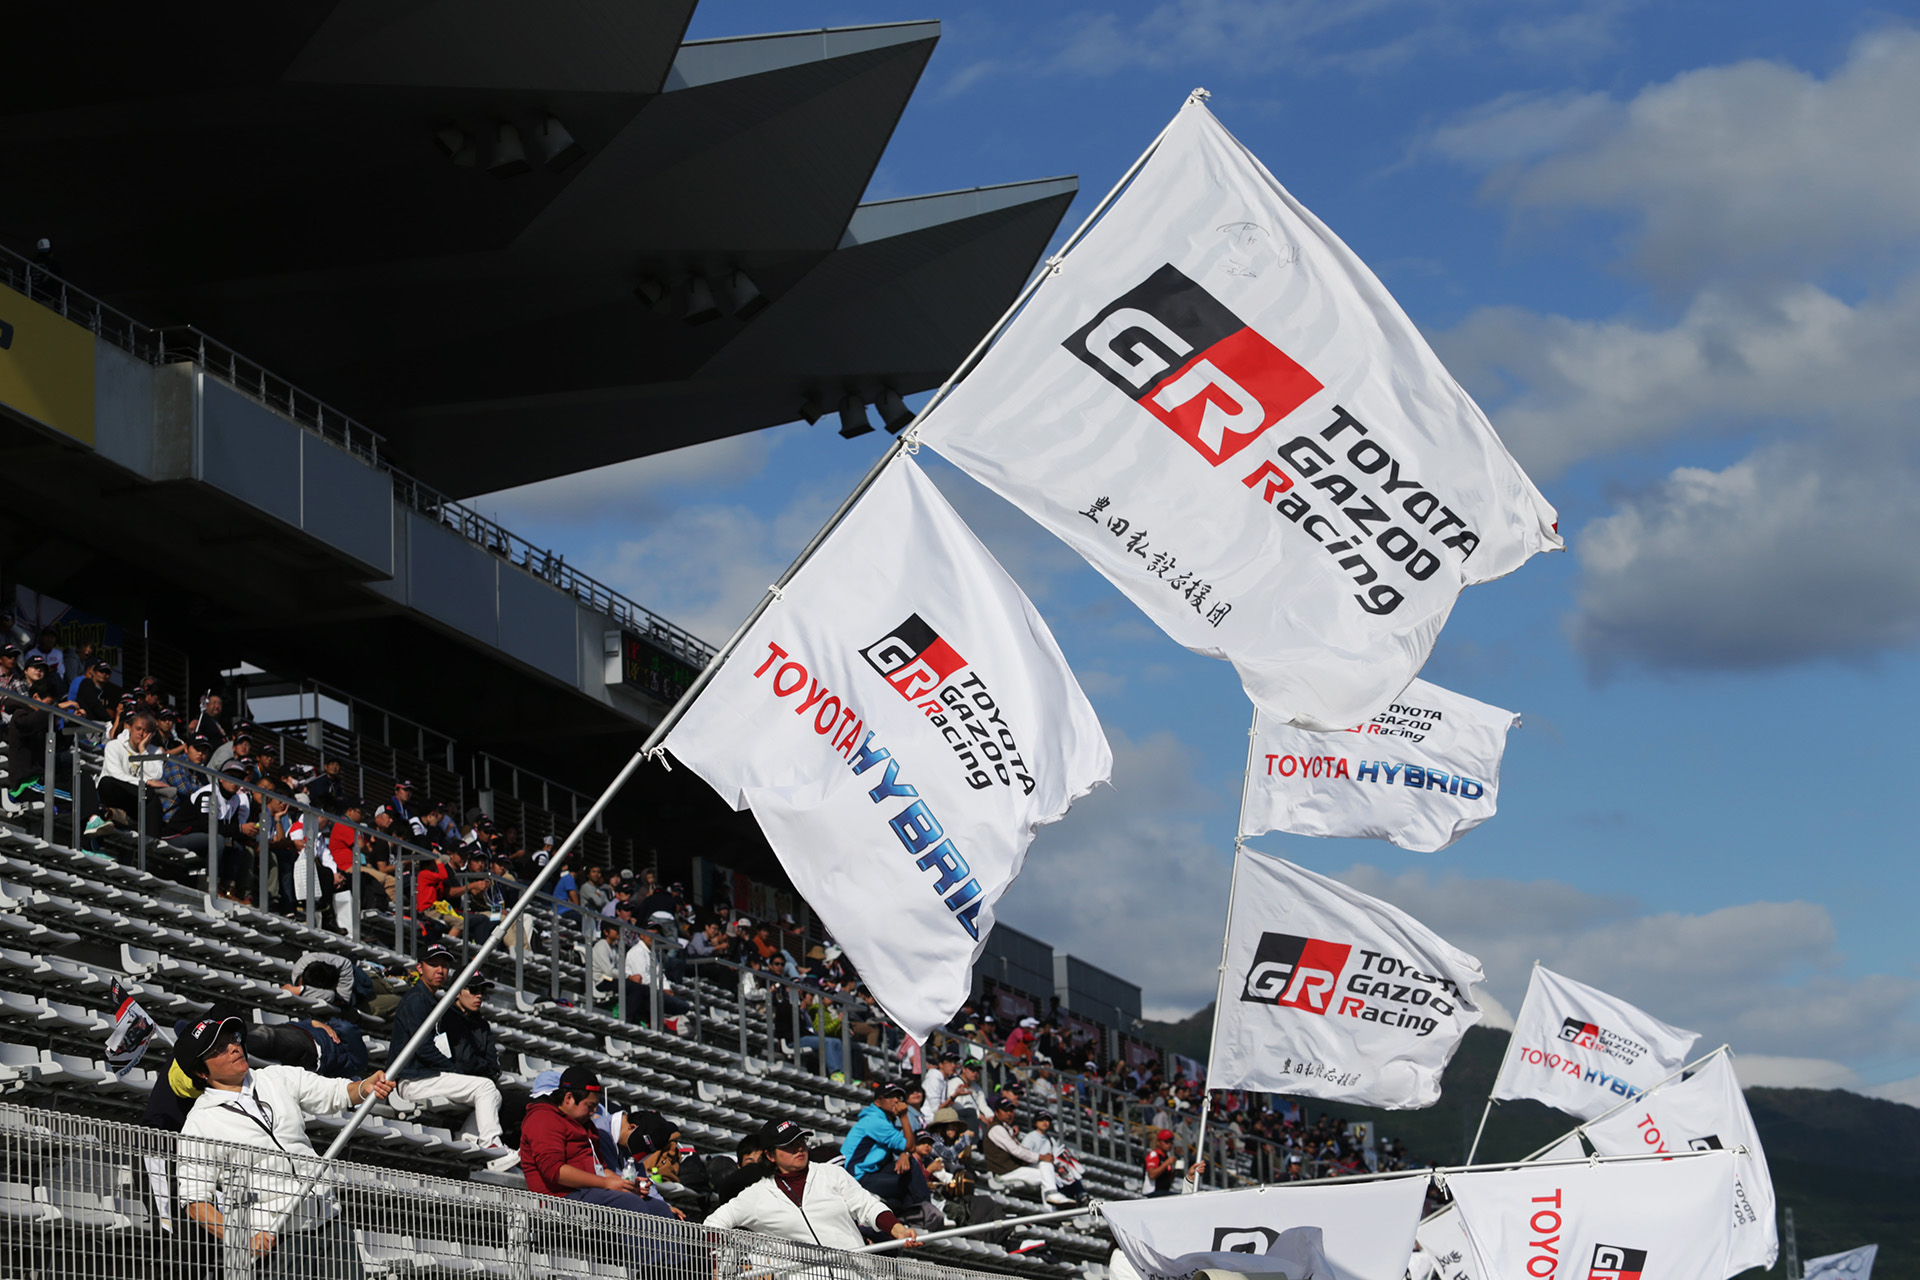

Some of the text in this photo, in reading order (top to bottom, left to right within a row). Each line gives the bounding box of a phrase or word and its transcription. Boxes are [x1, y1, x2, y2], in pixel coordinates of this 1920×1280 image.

[1082, 304, 1268, 458] GR
[1319, 404, 1481, 562] TOYOTA
[1277, 435, 1441, 582] GAZOO
[1241, 459, 1405, 616] Racing
[865, 634, 942, 698] GR
[753, 641, 863, 759] TOYOTA
[1370, 712, 1433, 732] GAZOO
[1388, 703, 1443, 721] OYOTA
[917, 699, 994, 790] Racing
[939, 685, 1011, 787] GAZOO
[960, 671, 1036, 797] TOYOTA
[1366, 723, 1426, 743] Racing
[1265, 754, 1484, 801] TOYOTA HYBRID
[1246, 959, 1337, 1011] GR
[1346, 974, 1455, 1017] GAZOO
[1337, 996, 1439, 1037] Racing
[1559, 1024, 1599, 1051] GR
[1601, 1027, 1648, 1055] TOYOTA
[1594, 1043, 1634, 1066] Racing
[1598, 1036, 1640, 1058] GAZOO
[1520, 1047, 1649, 1104] TOYOTA HYBR
[1636, 1112, 1674, 1161] TOY
[1735, 1180, 1757, 1223] TOYOTA
[1526, 1188, 1562, 1280] TOYO
